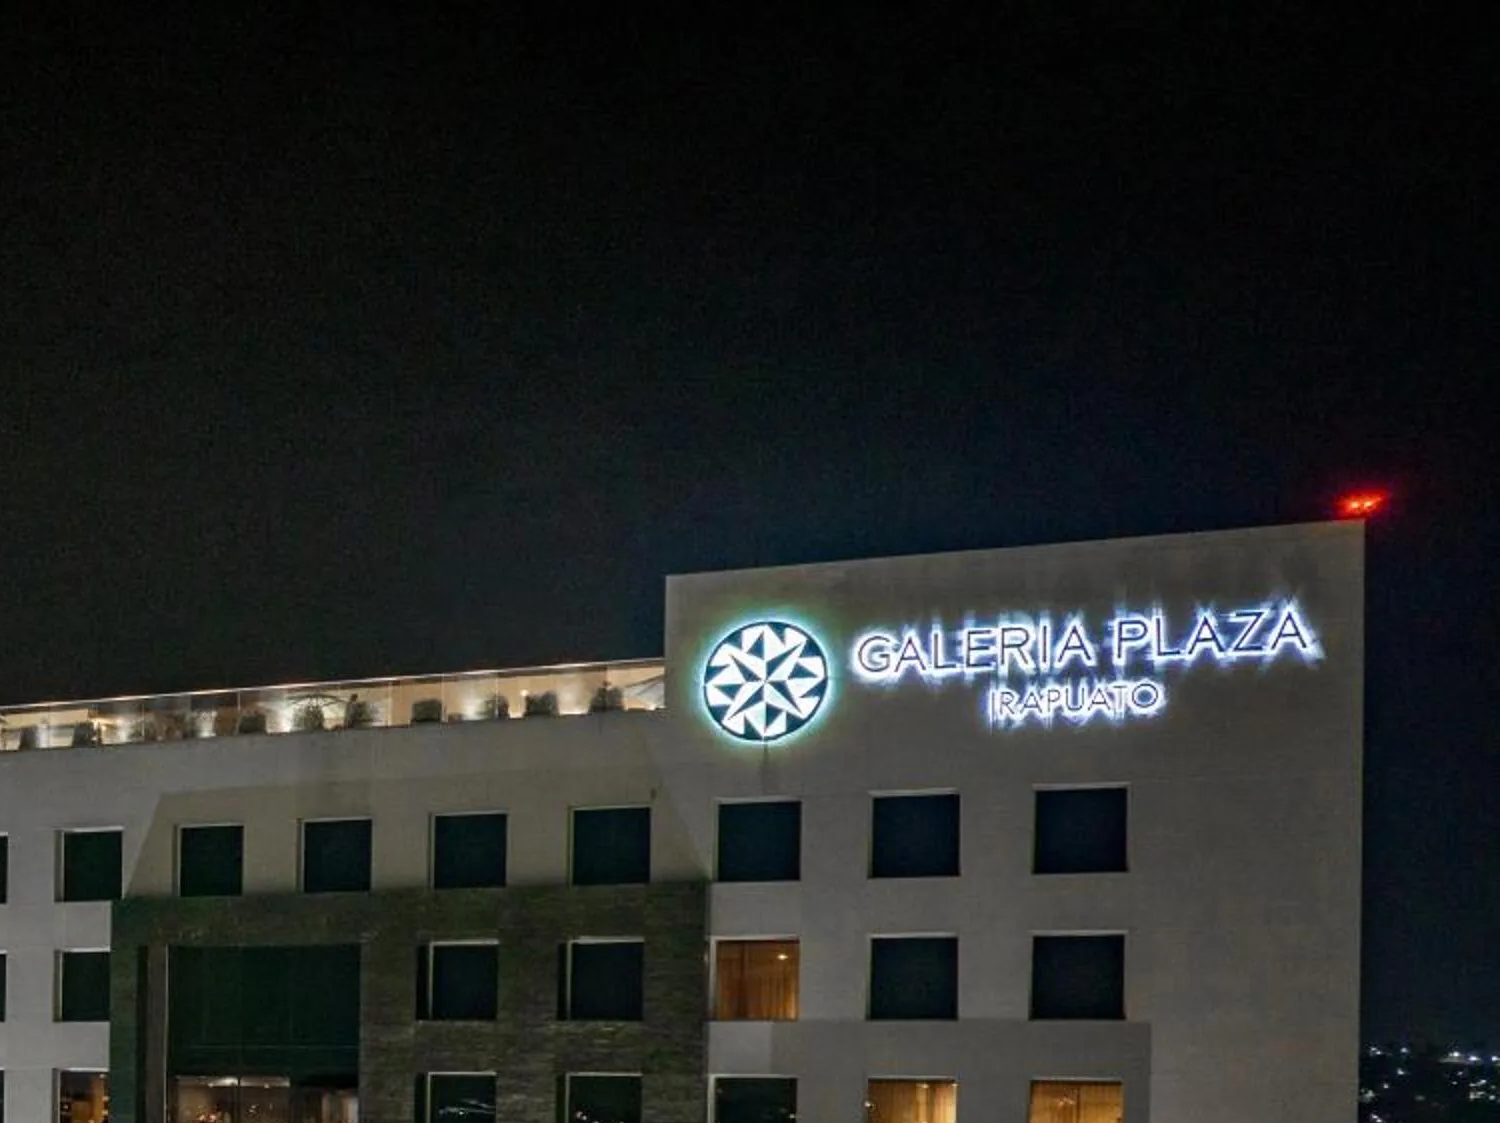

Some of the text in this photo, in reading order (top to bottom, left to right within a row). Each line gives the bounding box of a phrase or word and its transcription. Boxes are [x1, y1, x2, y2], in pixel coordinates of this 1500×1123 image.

[854, 604, 1314, 674] GALERIA PLAZA
[986, 680, 1164, 721] IRAPUATO
